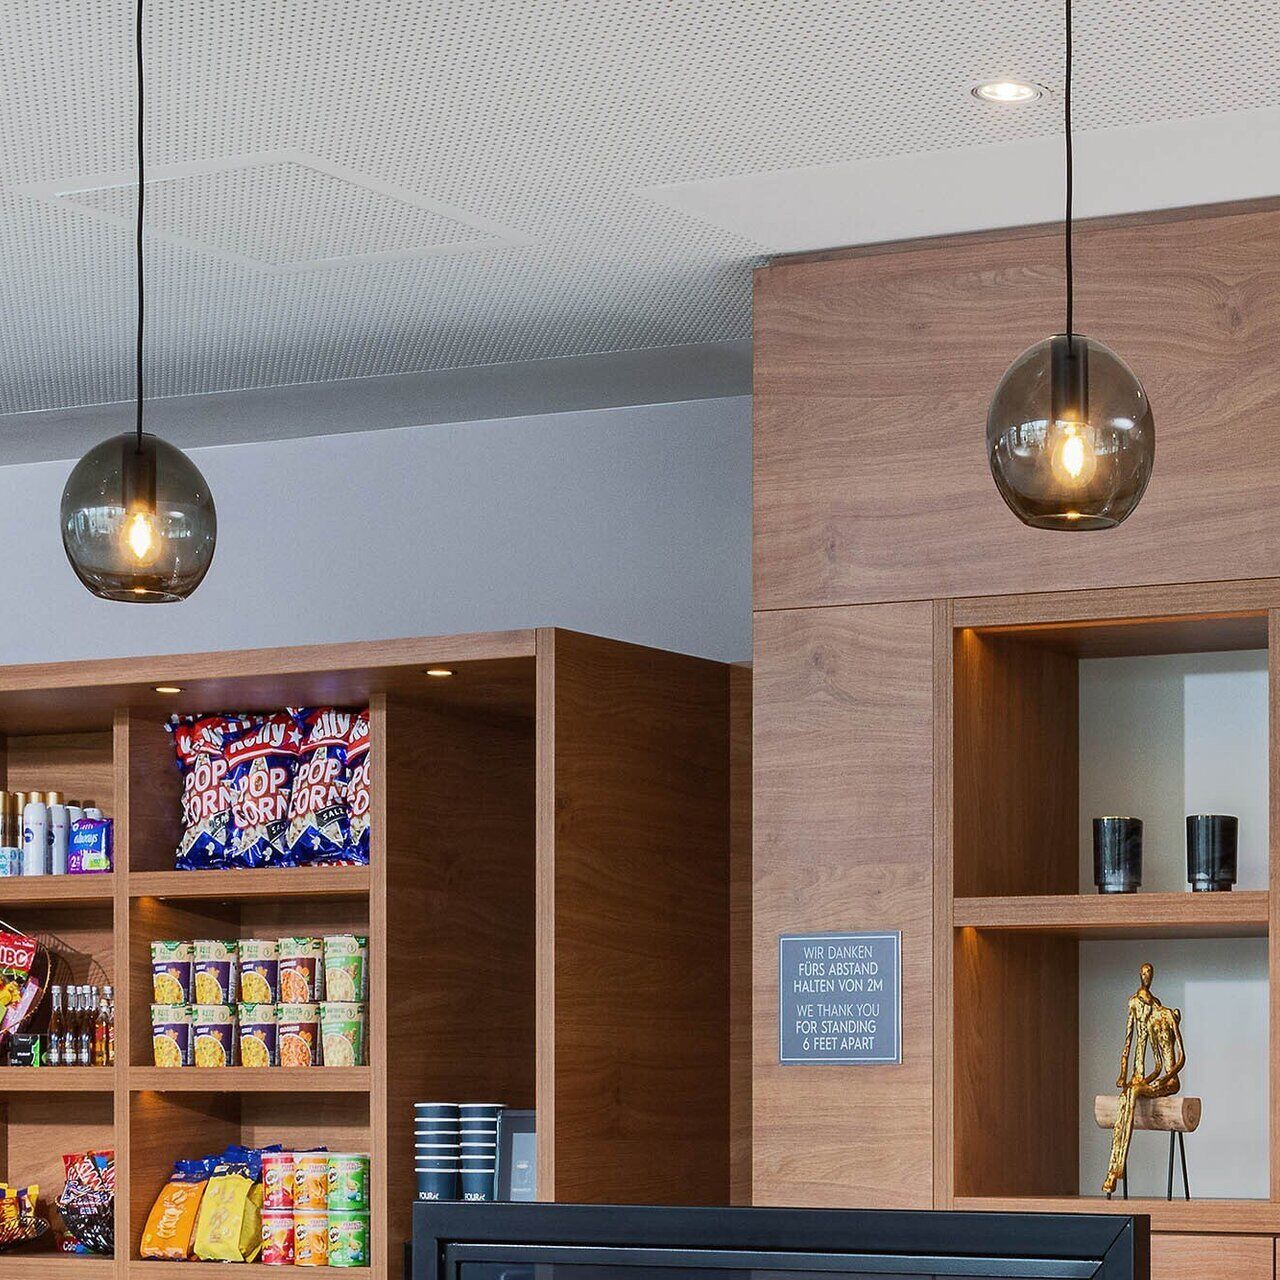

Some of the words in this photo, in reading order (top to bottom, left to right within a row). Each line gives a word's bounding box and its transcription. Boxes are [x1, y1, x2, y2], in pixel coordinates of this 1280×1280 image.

[185, 759, 228, 792] POP
[297, 758, 342, 789] POP
[237, 767, 287, 802] POP
[803, 946, 824, 959] WIR
[827, 945, 873, 960] DANKEN
[798, 960, 825, 977] FÜRS
[828, 962, 879, 976] ABSTAND
[793, 980, 835, 993] HALTEN
[838, 979, 863, 993] VON
[867, 978, 883, 991] 2M
[796, 1005, 814, 1018] WE
[817, 1004, 854, 1017] THANK
[856, 1003, 880, 1017] YOU
[795, 1020, 818, 1034] FOR
[821, 1020, 877, 1034] STANDING
[802, 1037, 810, 1051] 6
[813, 1037, 837, 1050] FEET
[840, 1036, 875, 1050] APART
